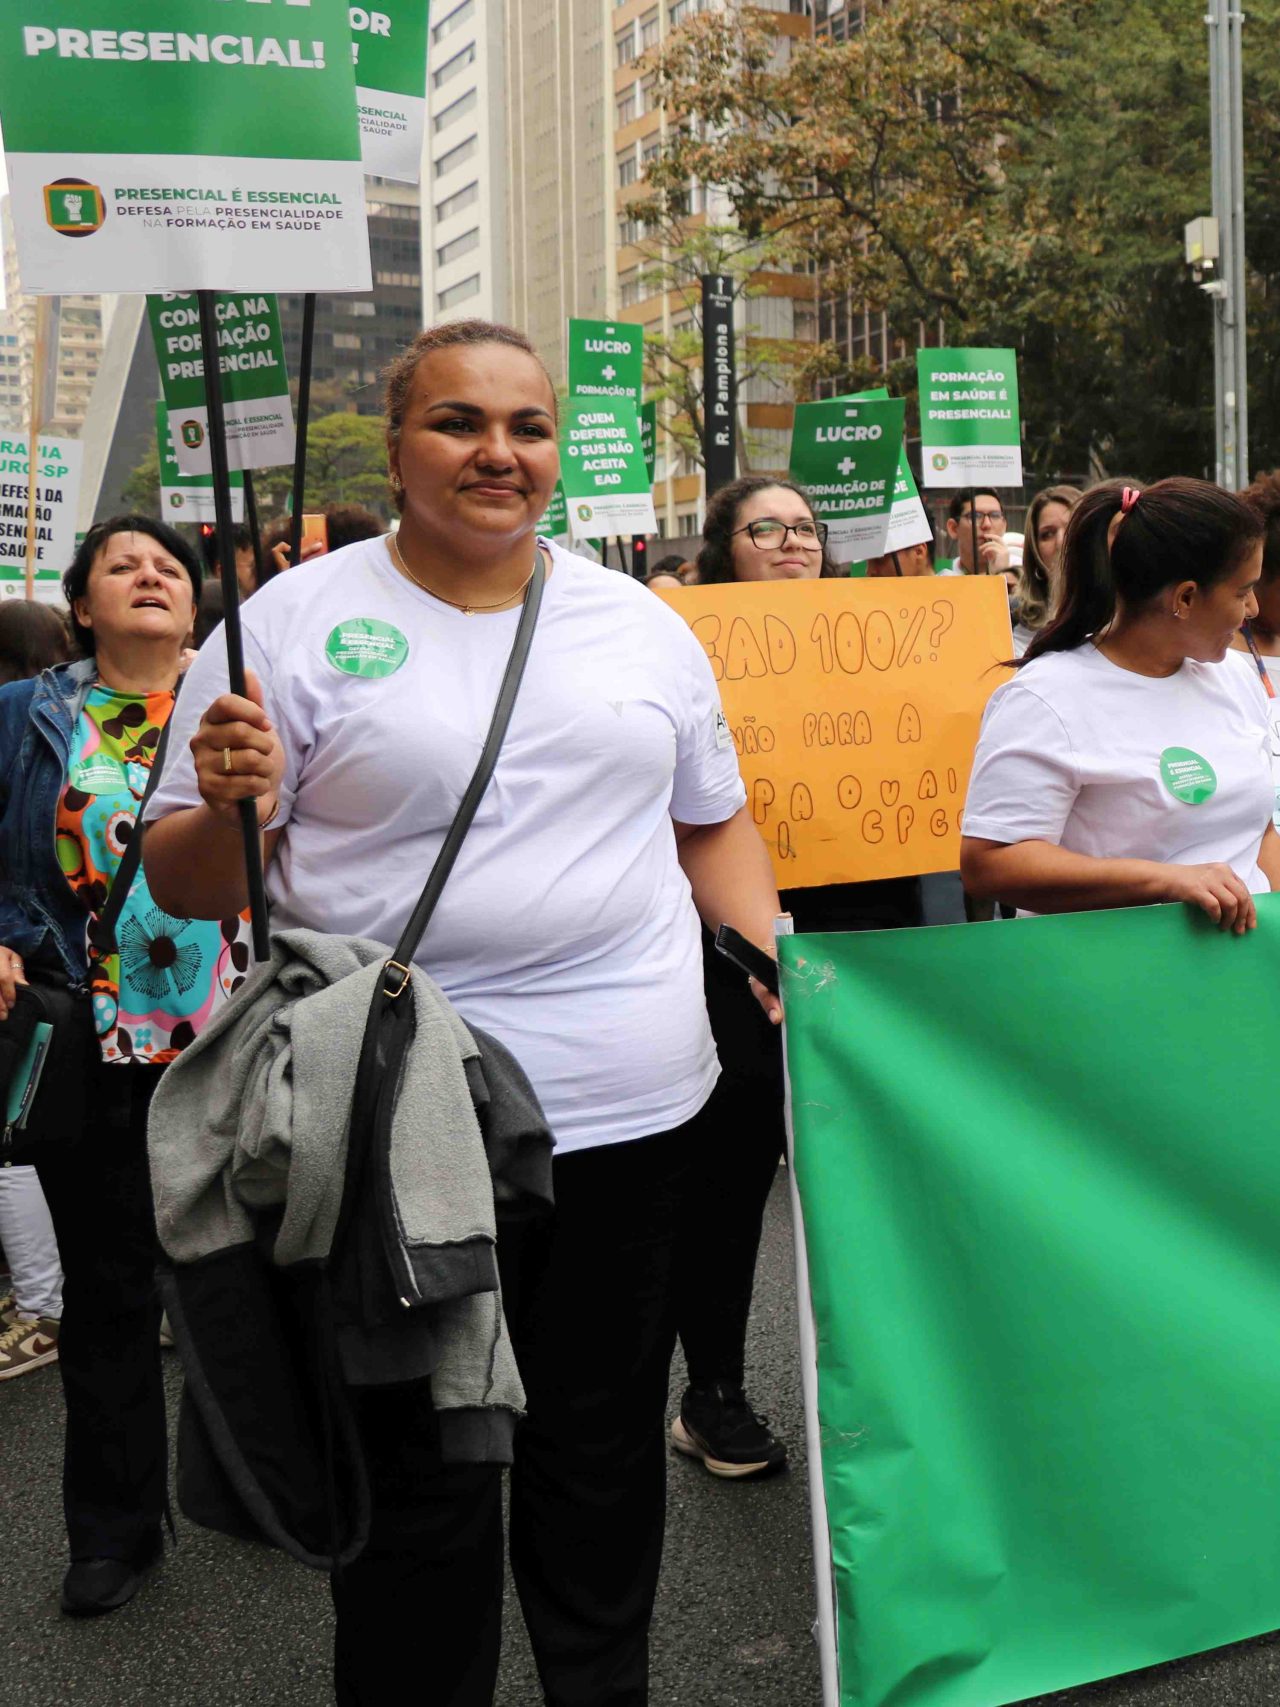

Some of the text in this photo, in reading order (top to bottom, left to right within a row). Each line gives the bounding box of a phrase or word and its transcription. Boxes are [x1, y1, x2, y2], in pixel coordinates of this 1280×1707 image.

[23, 25, 326, 69] PRESENCIAL!
[359, 117, 407, 131] CIALIDADE
[363, 125, 392, 136] SAÚDE
[114, 187, 343, 205] PRESENCIAL É ESSENCIAL
[116, 206, 343, 219] DEFESA PELA PRESENCIALIDADE
[143, 217, 321, 231] NA FORMAÇÃO EM SAÚDE
[160, 297, 270, 328] COMÇA NA
[585, 339, 631, 354] LUCRO
[167, 350, 278, 380] PREENCIAL
[715, 323, 731, 416] Pamplona
[931, 370, 1005, 384] FORMAÇÃO
[576, 384, 636, 397] FORMAÇÃO DE
[930, 387, 1008, 401] EM SAÚDE É
[578, 413, 615, 426] QUEM
[929, 409, 1011, 420] PRESENCIAL!
[570, 427, 627, 441] DEFENDE
[716, 425, 730, 446] R.
[815, 425, 882, 442] LUCRO
[568, 440, 634, 457] O SUS NÃO
[583, 458, 627, 472] ACEITA
[594, 473, 621, 486] EAD
[870, 480, 885, 490] DE
[45, 488, 63, 503] DA
[811, 600, 954, 675] 100%?
[803, 710, 872, 747] PARA
[897, 703, 921, 744] A
